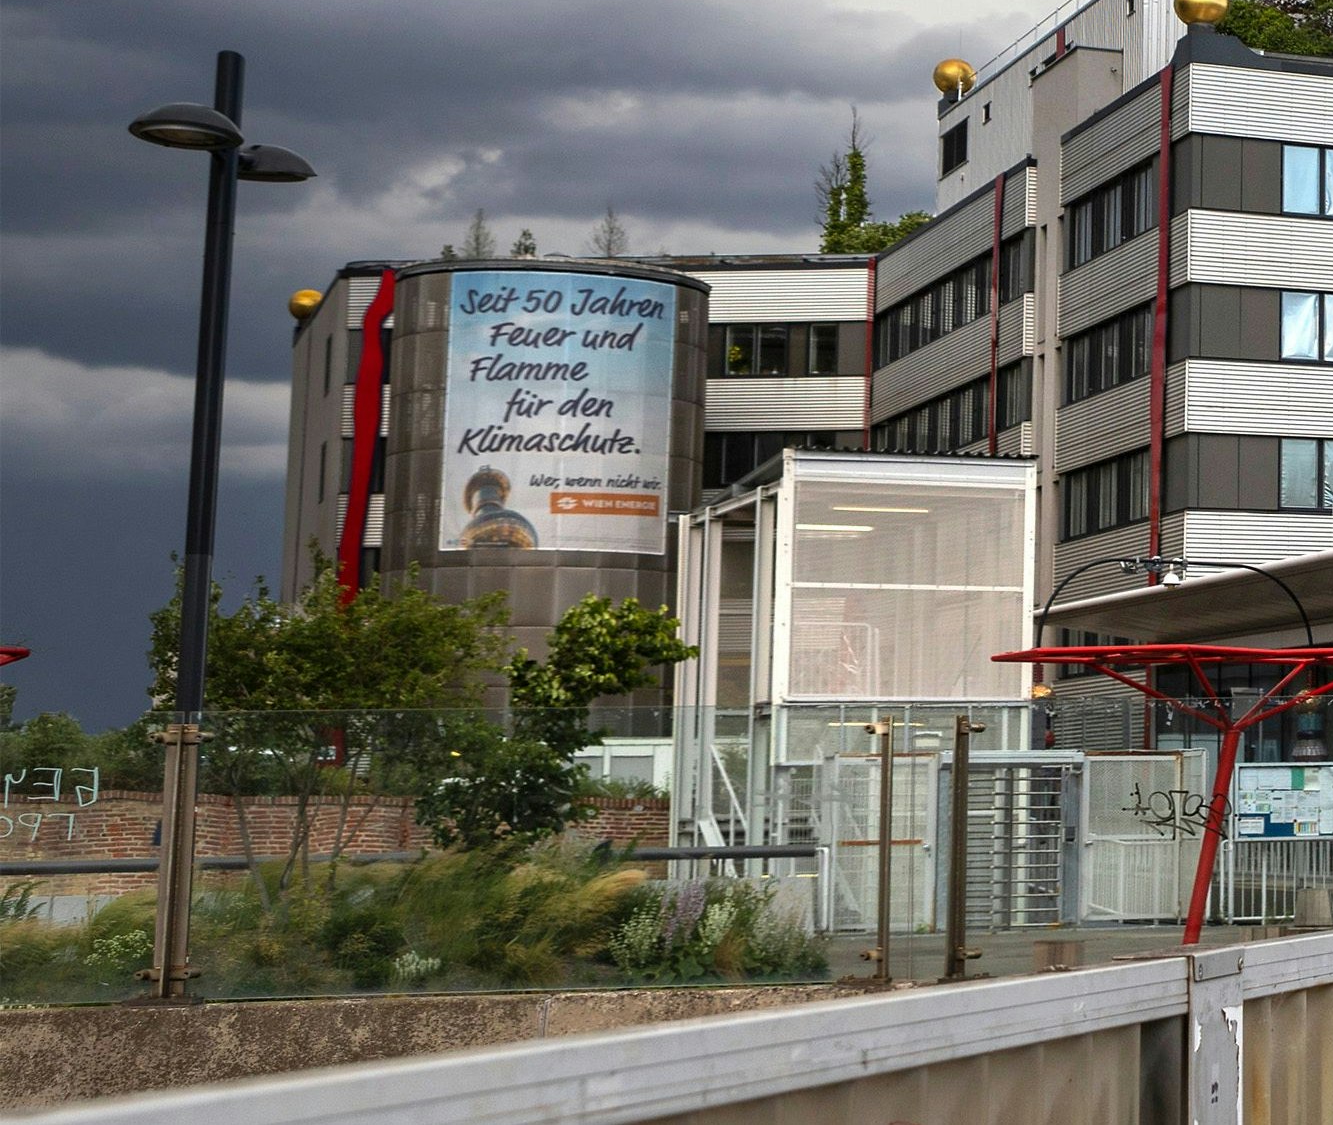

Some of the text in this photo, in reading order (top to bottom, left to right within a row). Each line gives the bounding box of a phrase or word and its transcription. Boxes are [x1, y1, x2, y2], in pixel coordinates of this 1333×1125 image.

[460, 286, 664, 320] Seit 50 Jahren
[490, 323, 644, 351] Feuer und
[470, 354, 589, 382] Flamme
[503, 388, 615, 422] für den
[457, 423, 641, 455] Klimaschutz.
[529, 474, 662, 490] Wer, wenn nicht wir.
[582, 499, 656, 510] WIEN ENERGIE
